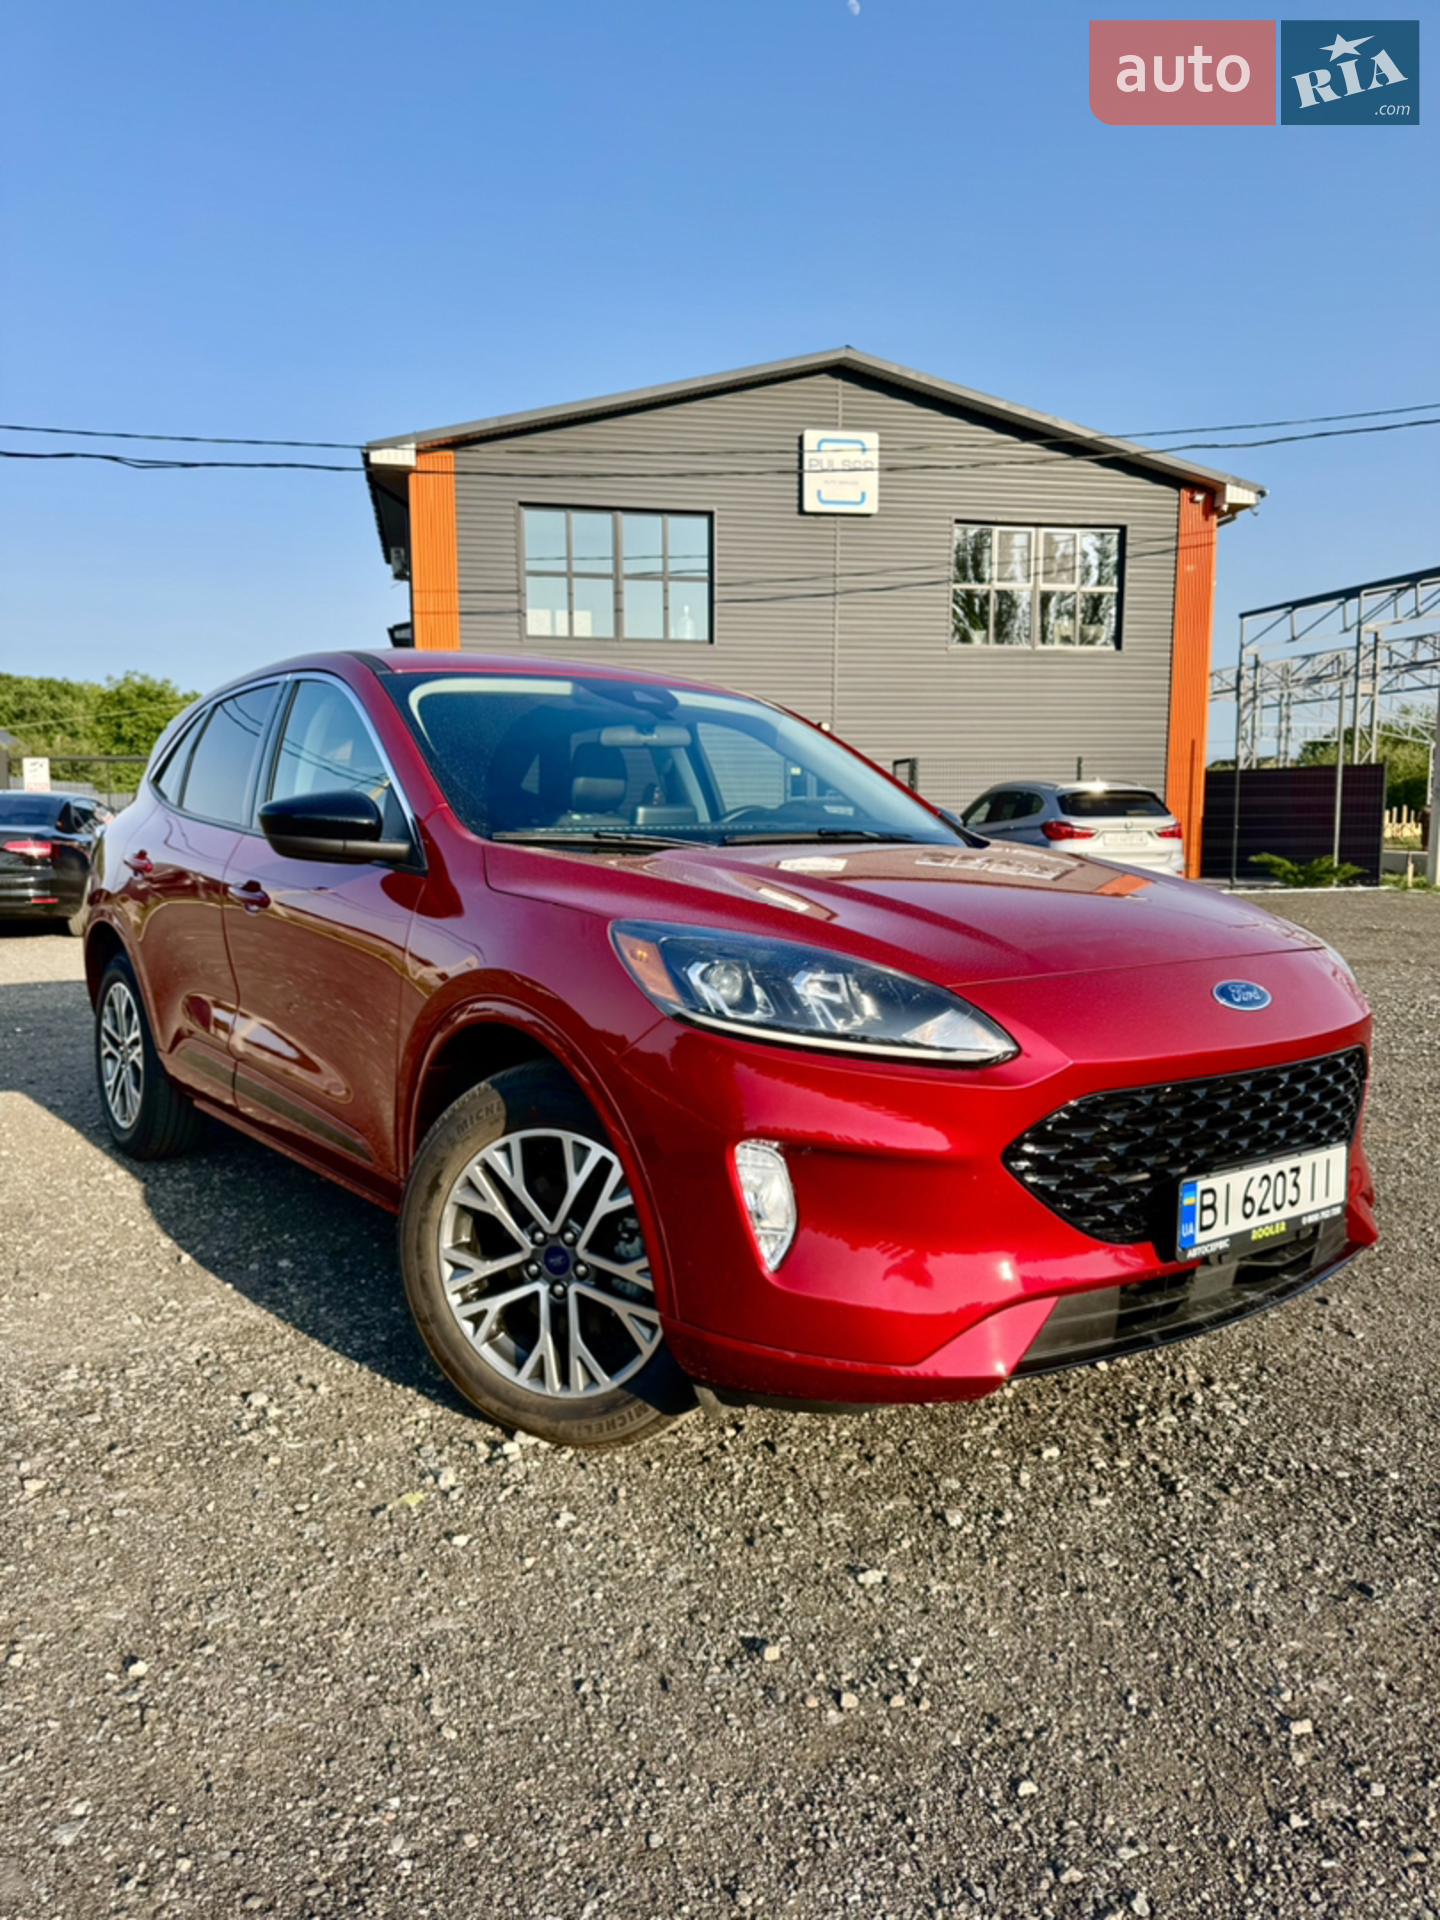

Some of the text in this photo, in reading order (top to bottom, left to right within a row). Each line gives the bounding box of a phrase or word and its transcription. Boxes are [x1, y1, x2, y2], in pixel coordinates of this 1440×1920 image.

[1228, 984, 1261, 1002] Ford
[1199, 1183, 1230, 1232] BI
[1242, 1166, 1301, 1220] 6203
[1181, 1222, 1195, 1237] UA
